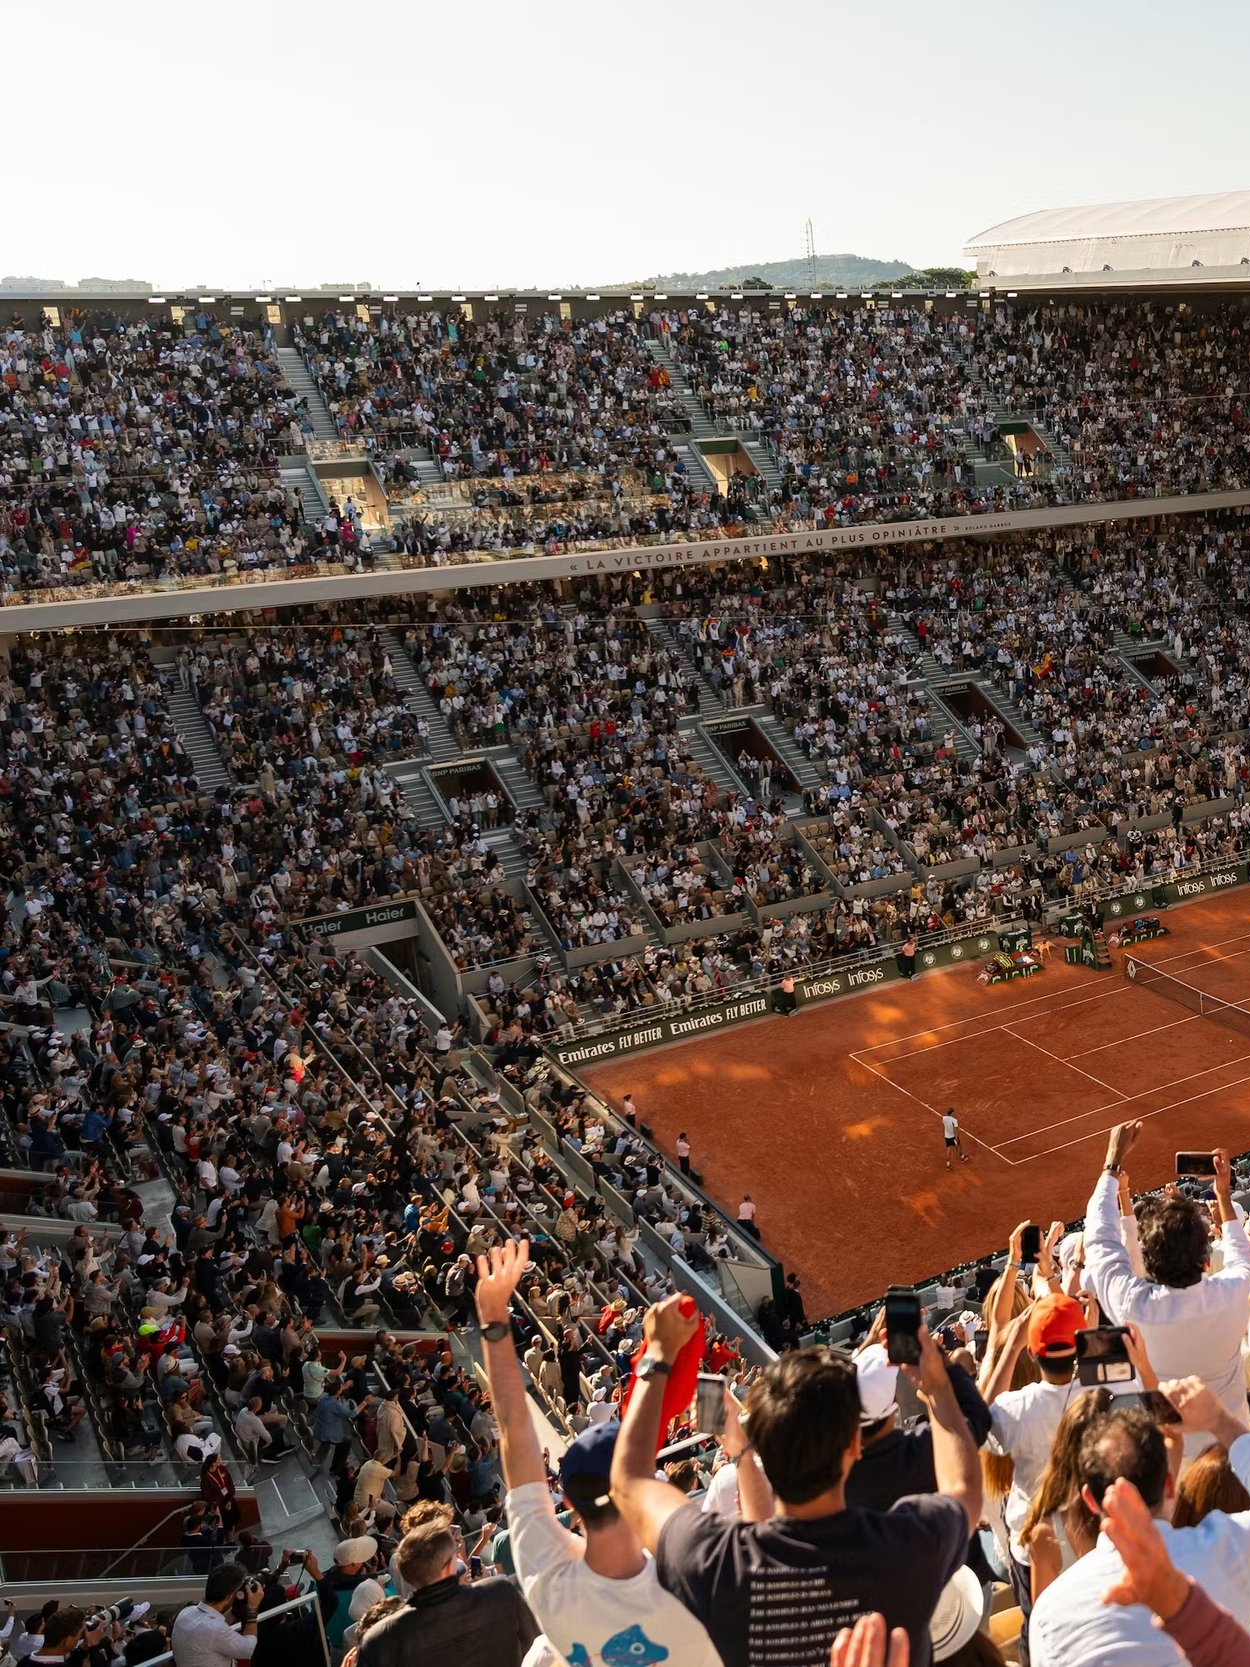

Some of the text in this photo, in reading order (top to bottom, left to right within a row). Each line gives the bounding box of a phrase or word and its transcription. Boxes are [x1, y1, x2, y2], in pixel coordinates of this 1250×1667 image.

[586, 560, 607, 571] LA
[614, 550, 694, 567] VICTOIRE
[702, 540, 799, 558] APPARTIENT
[805, 536, 823, 548] AU
[831, 532, 865, 545] PLUS
[872, 525, 947, 541] OPINIÂTRE
[432, 764, 481, 777] BNP PARIBAS
[1177, 880, 1205, 896] Infosys
[1210, 872, 1238, 887] Infosys
[366, 907, 404, 924] Haier
[302, 920, 342, 936] Haier
[848, 967, 884, 986] Infosys
[803, 979, 841, 998] Infosys
[671, 998, 767, 1035] Emirates FLY BETTER
[558, 1026, 663, 1064] Emirates FLY BETTER
